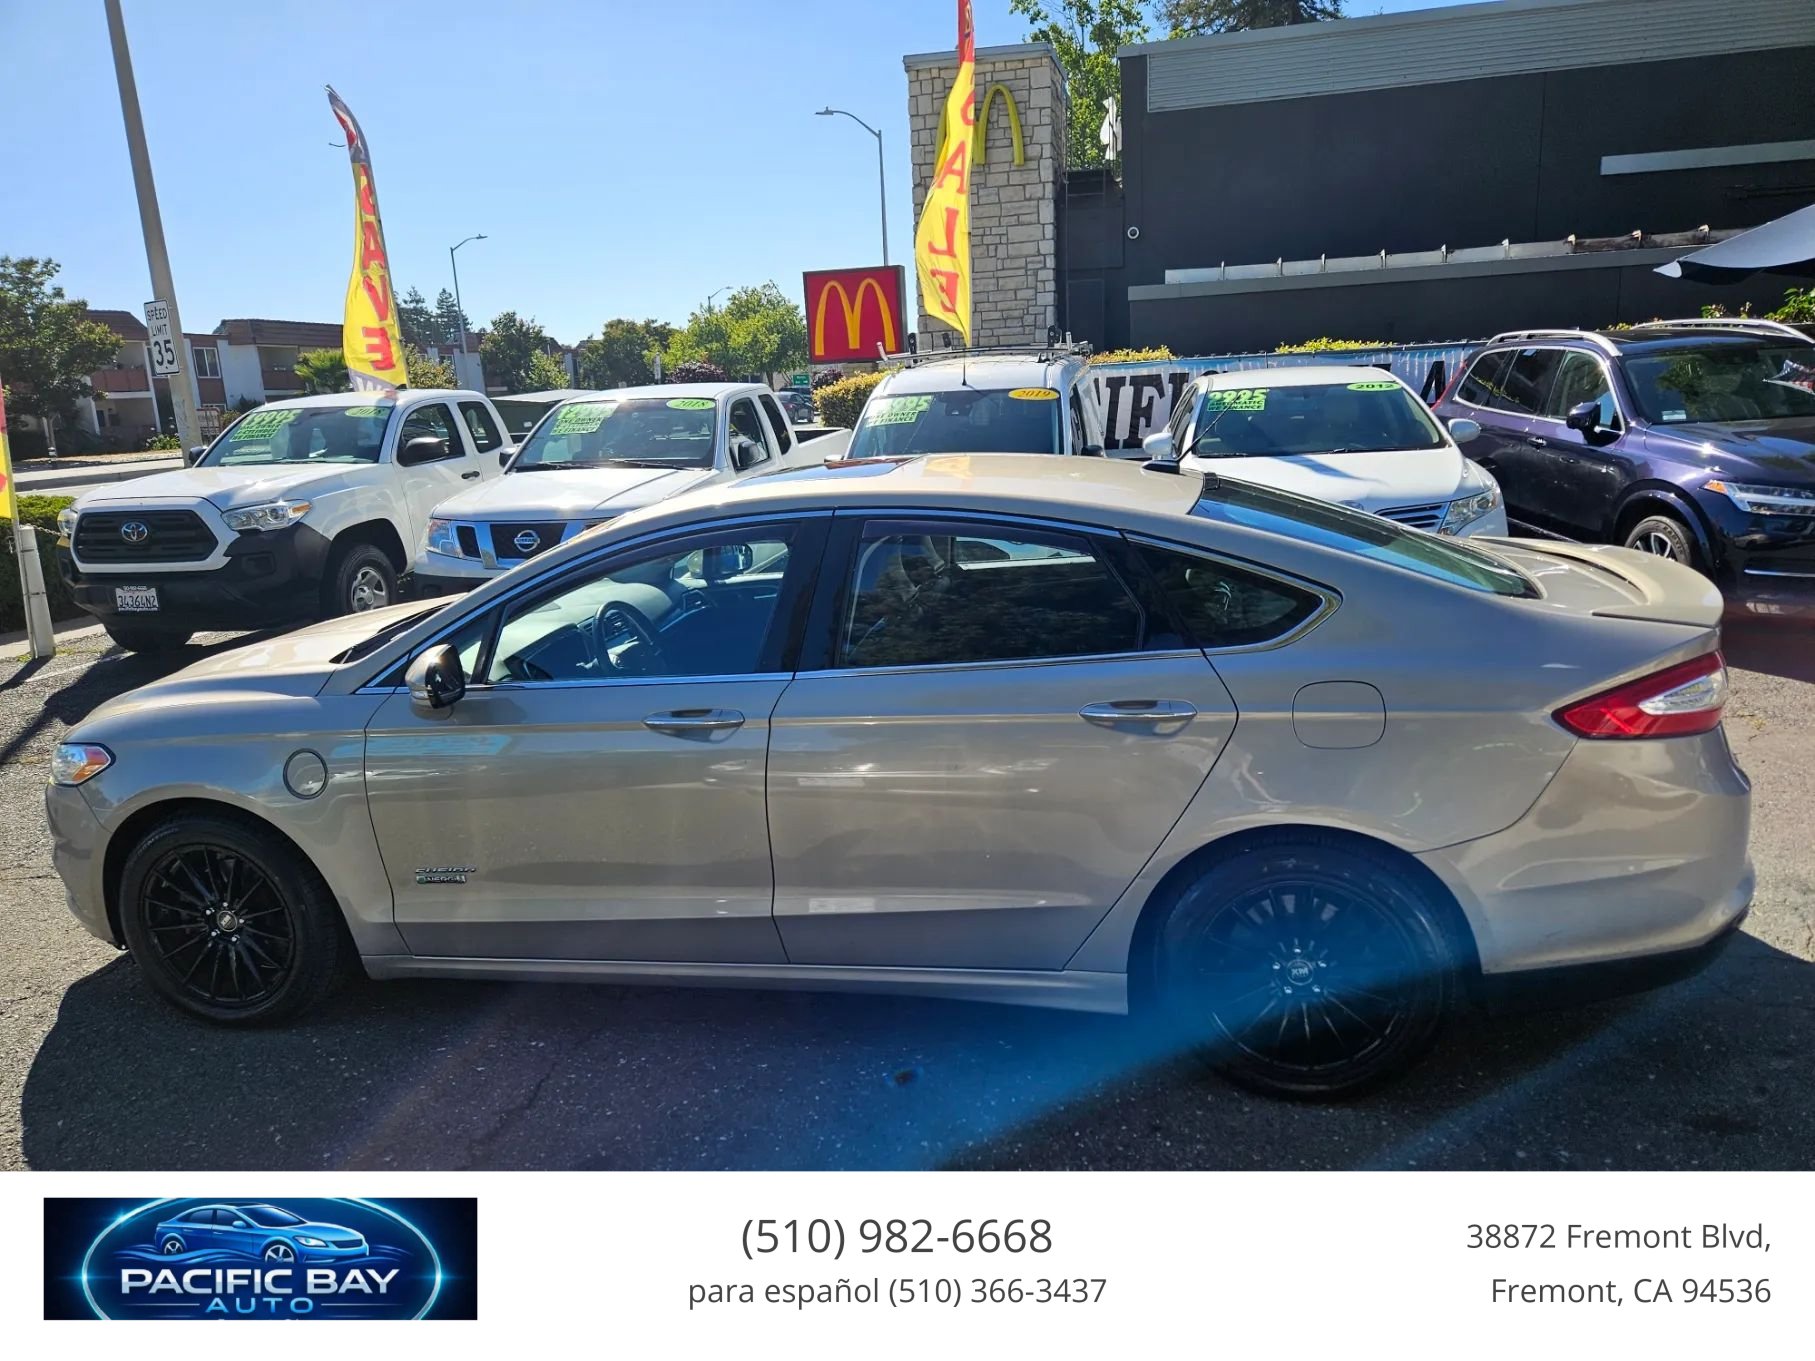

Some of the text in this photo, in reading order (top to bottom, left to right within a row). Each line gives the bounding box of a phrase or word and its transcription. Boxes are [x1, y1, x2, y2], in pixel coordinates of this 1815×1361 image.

[147, 306, 168, 321] SPEED
[151, 324, 168, 337] LIMIT
[153, 339, 175, 366] 35
[1017, 390, 1051, 398] 2019
